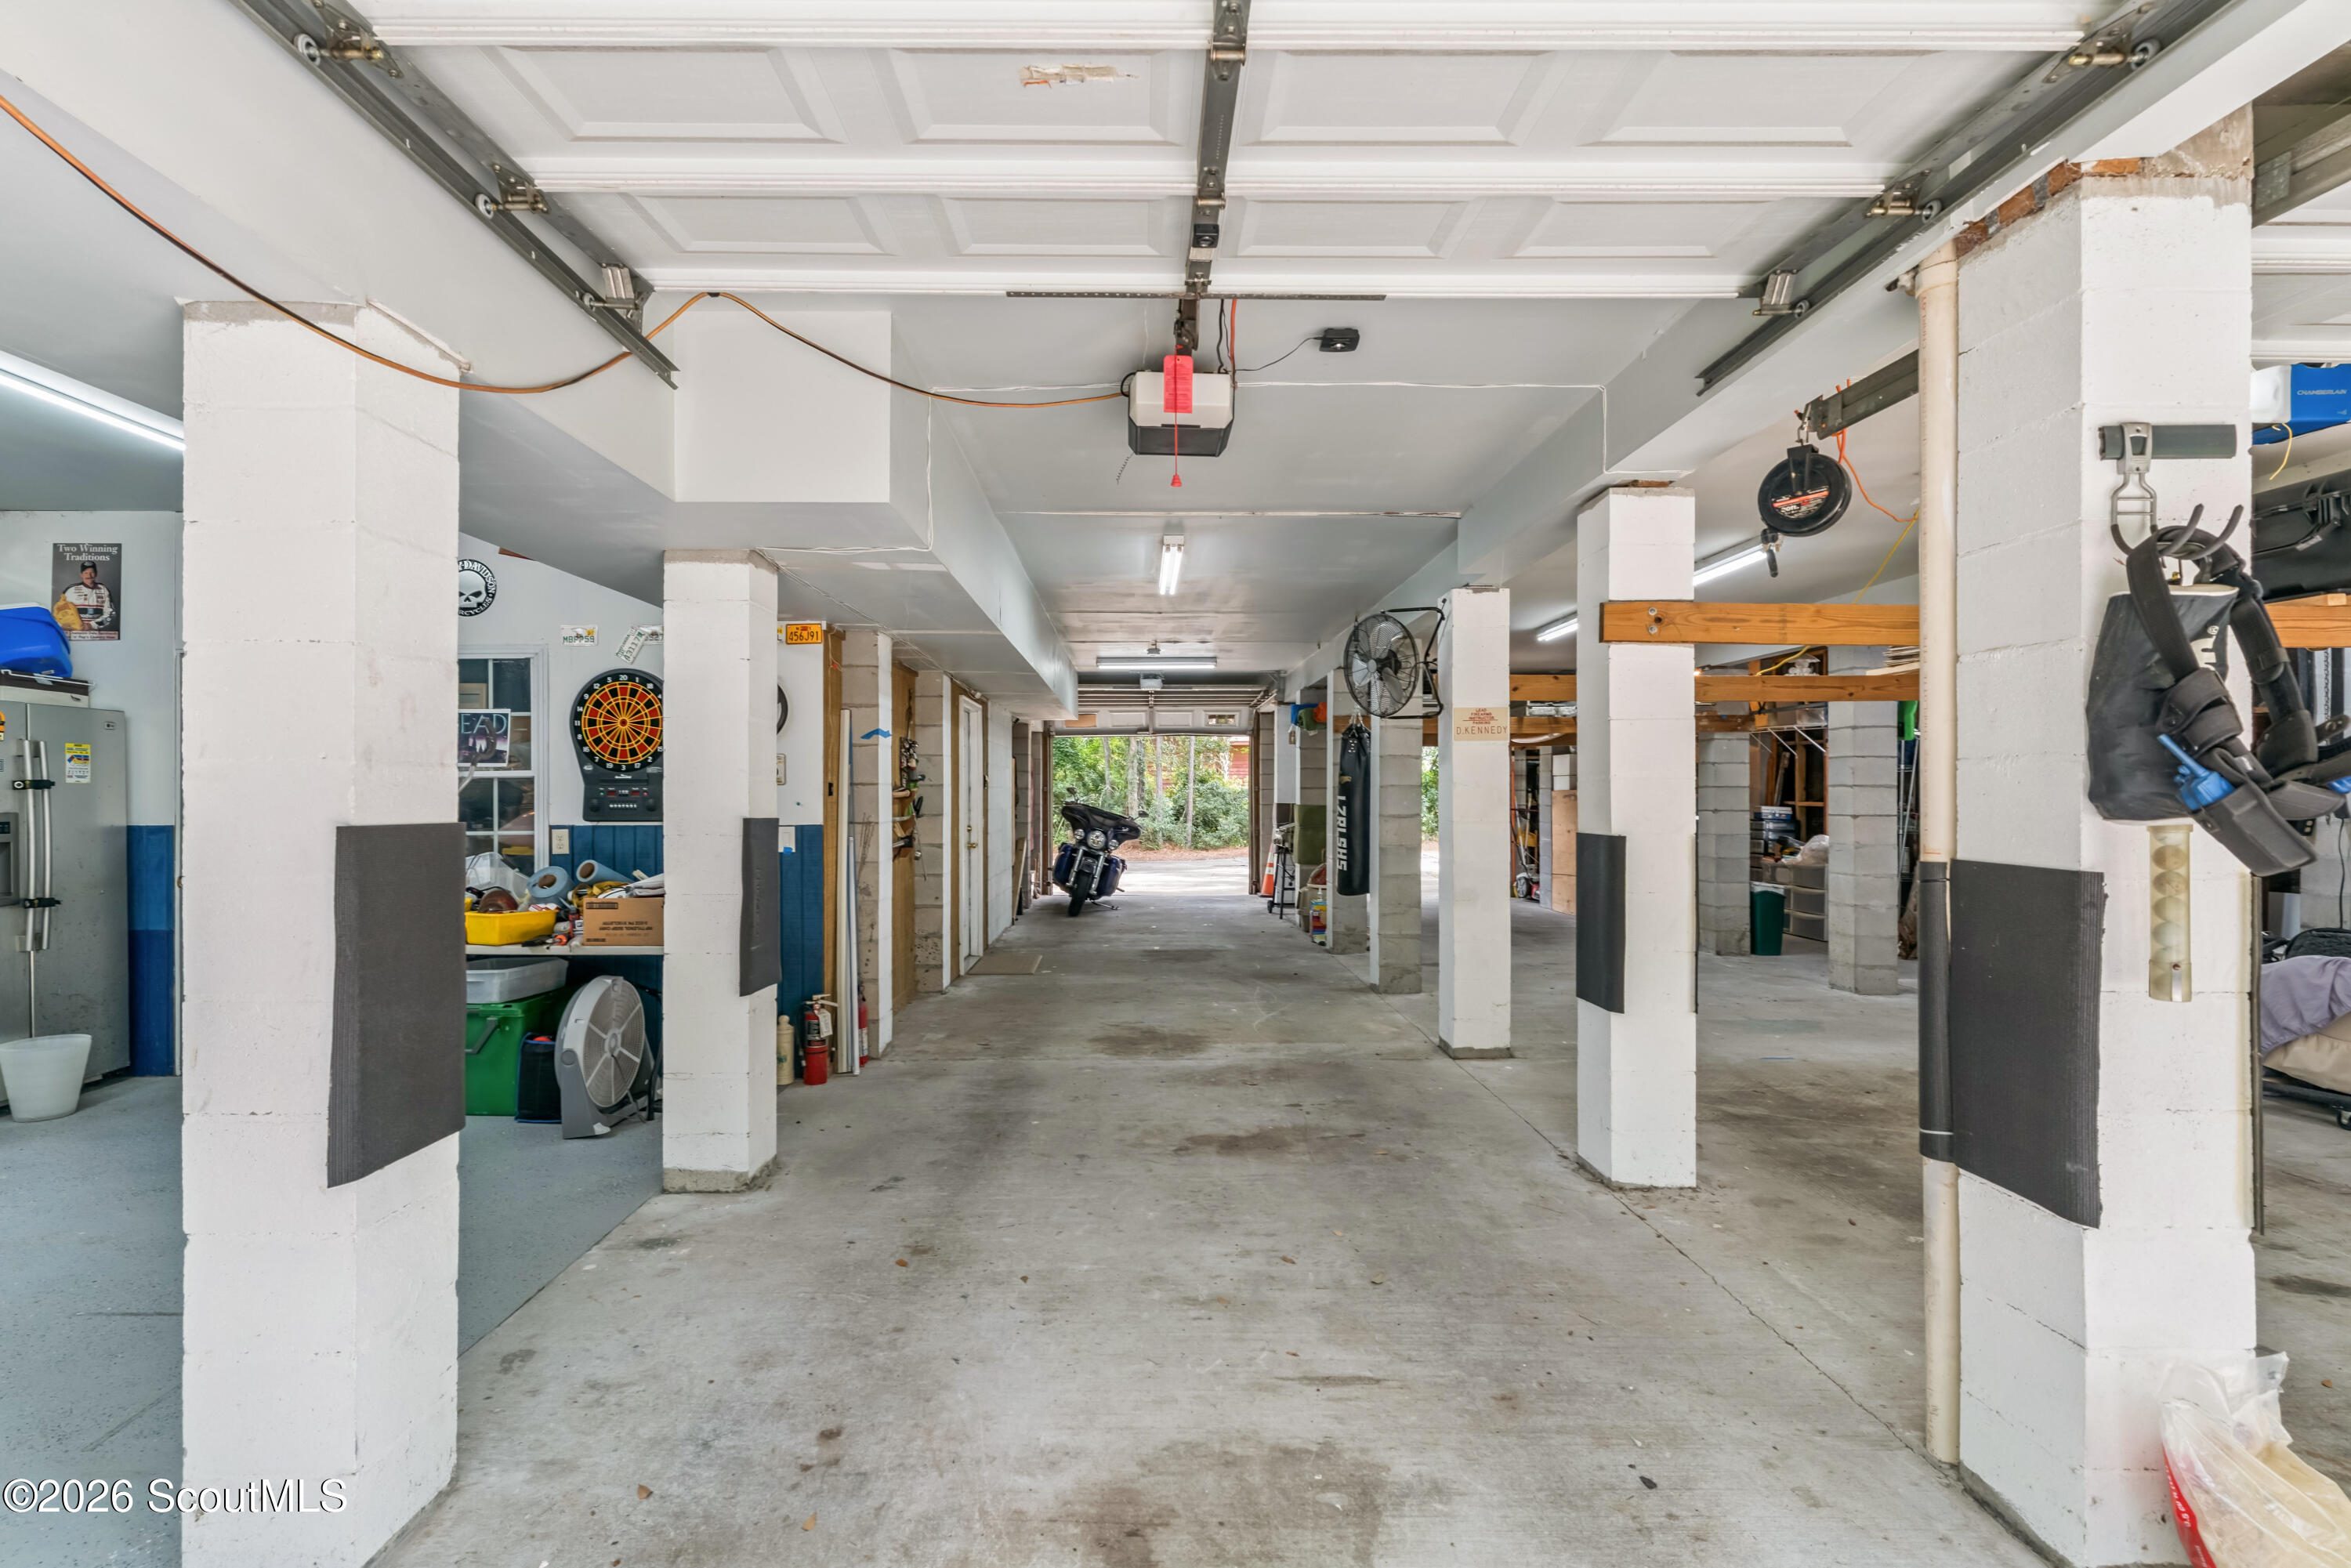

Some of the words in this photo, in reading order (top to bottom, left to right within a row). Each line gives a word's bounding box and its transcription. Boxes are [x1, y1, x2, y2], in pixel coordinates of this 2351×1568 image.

[79, 543, 118, 555] Winning
[63, 552, 110, 561] Traditions
[461, 713, 508, 733] EAD
